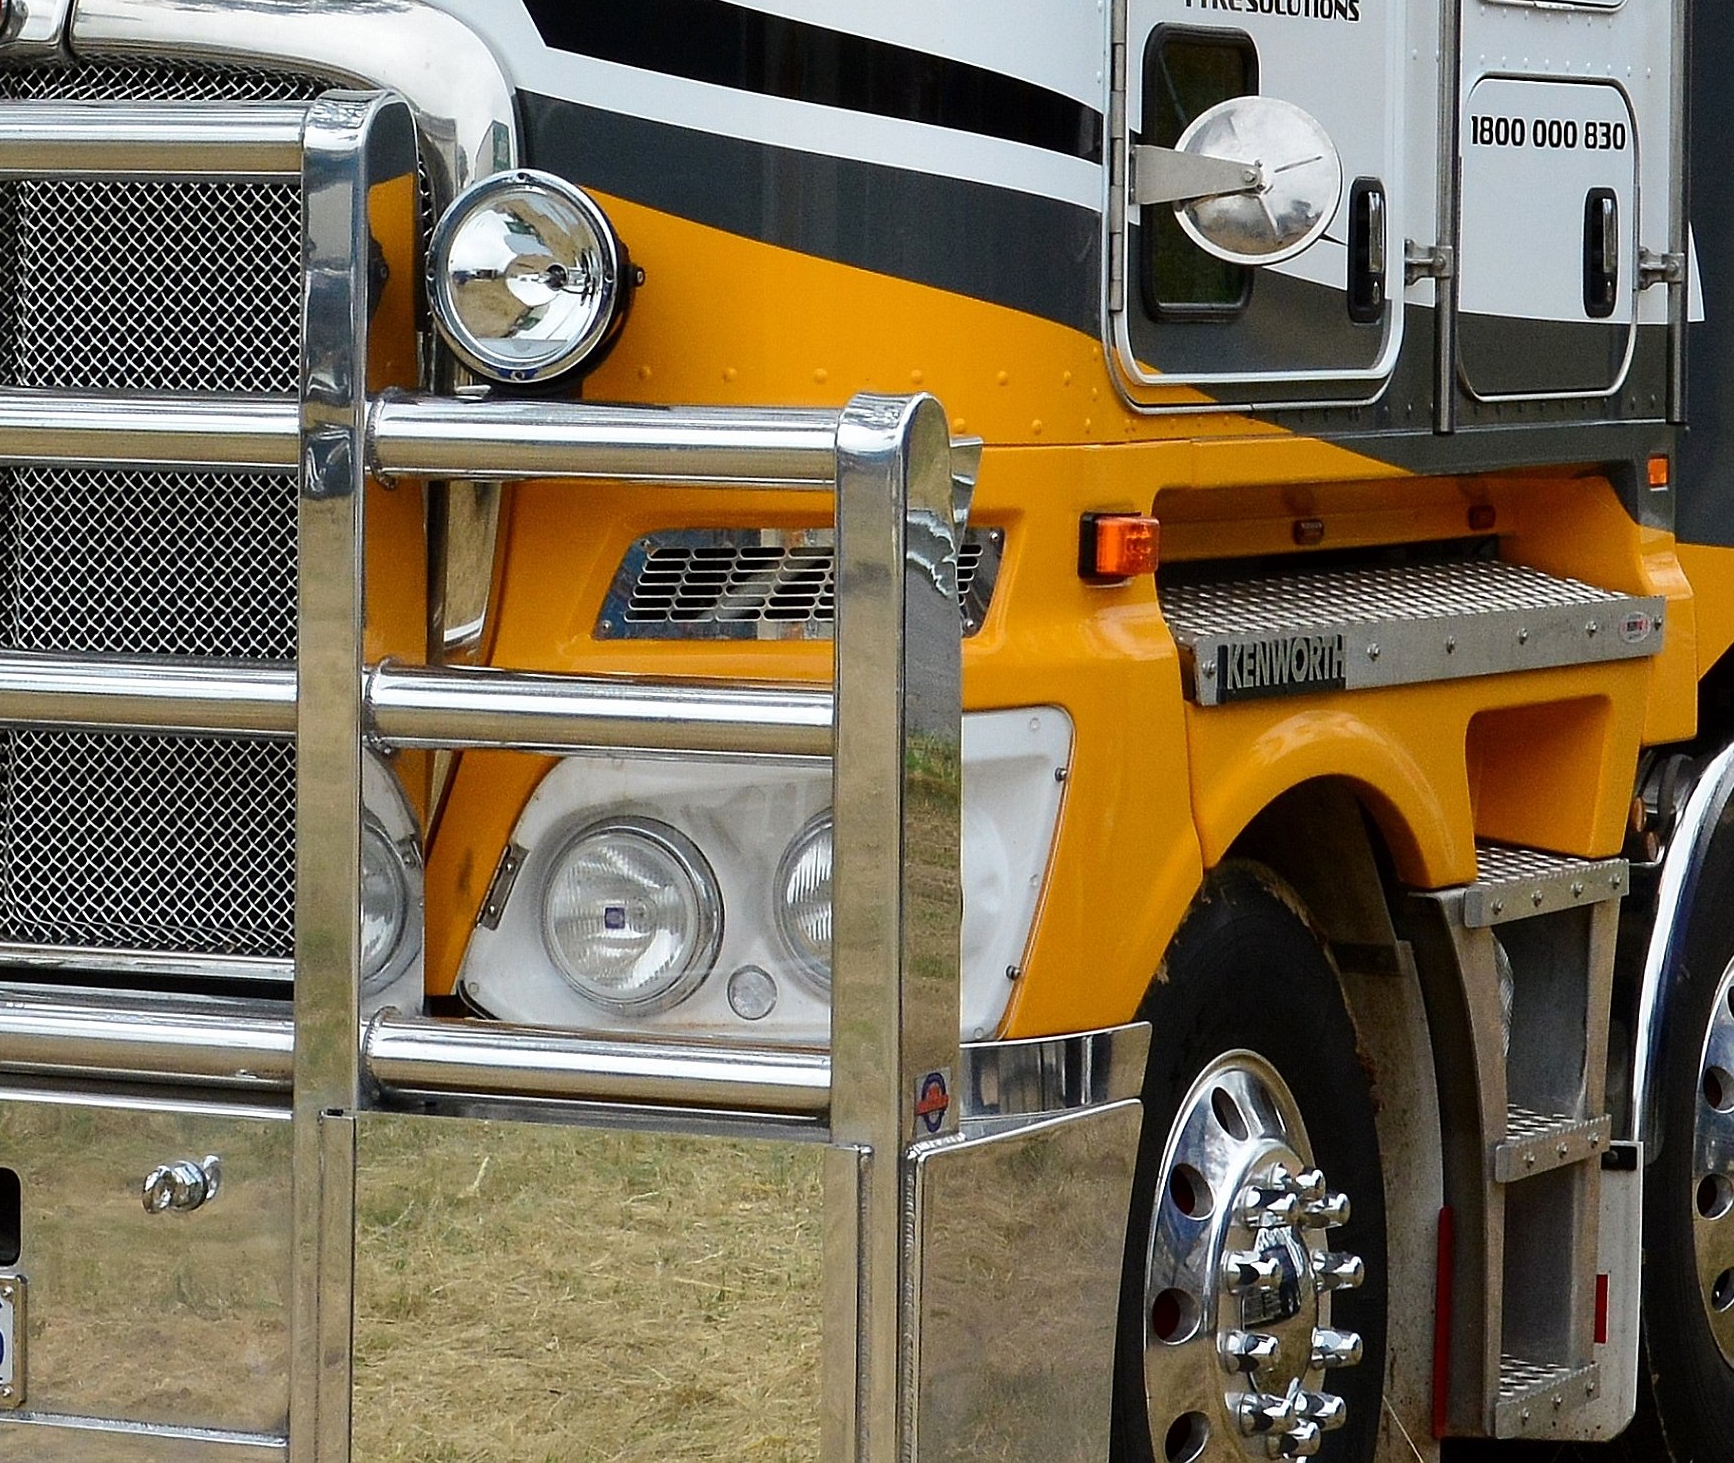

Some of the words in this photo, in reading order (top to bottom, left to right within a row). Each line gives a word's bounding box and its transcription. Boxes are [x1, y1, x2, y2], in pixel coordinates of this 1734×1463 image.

[1470, 115, 1525, 148] 1800
[1532, 118, 1577, 149] 000
[1584, 121, 1625, 151] 830
[1225, 634, 1347, 691] KENWORTH
